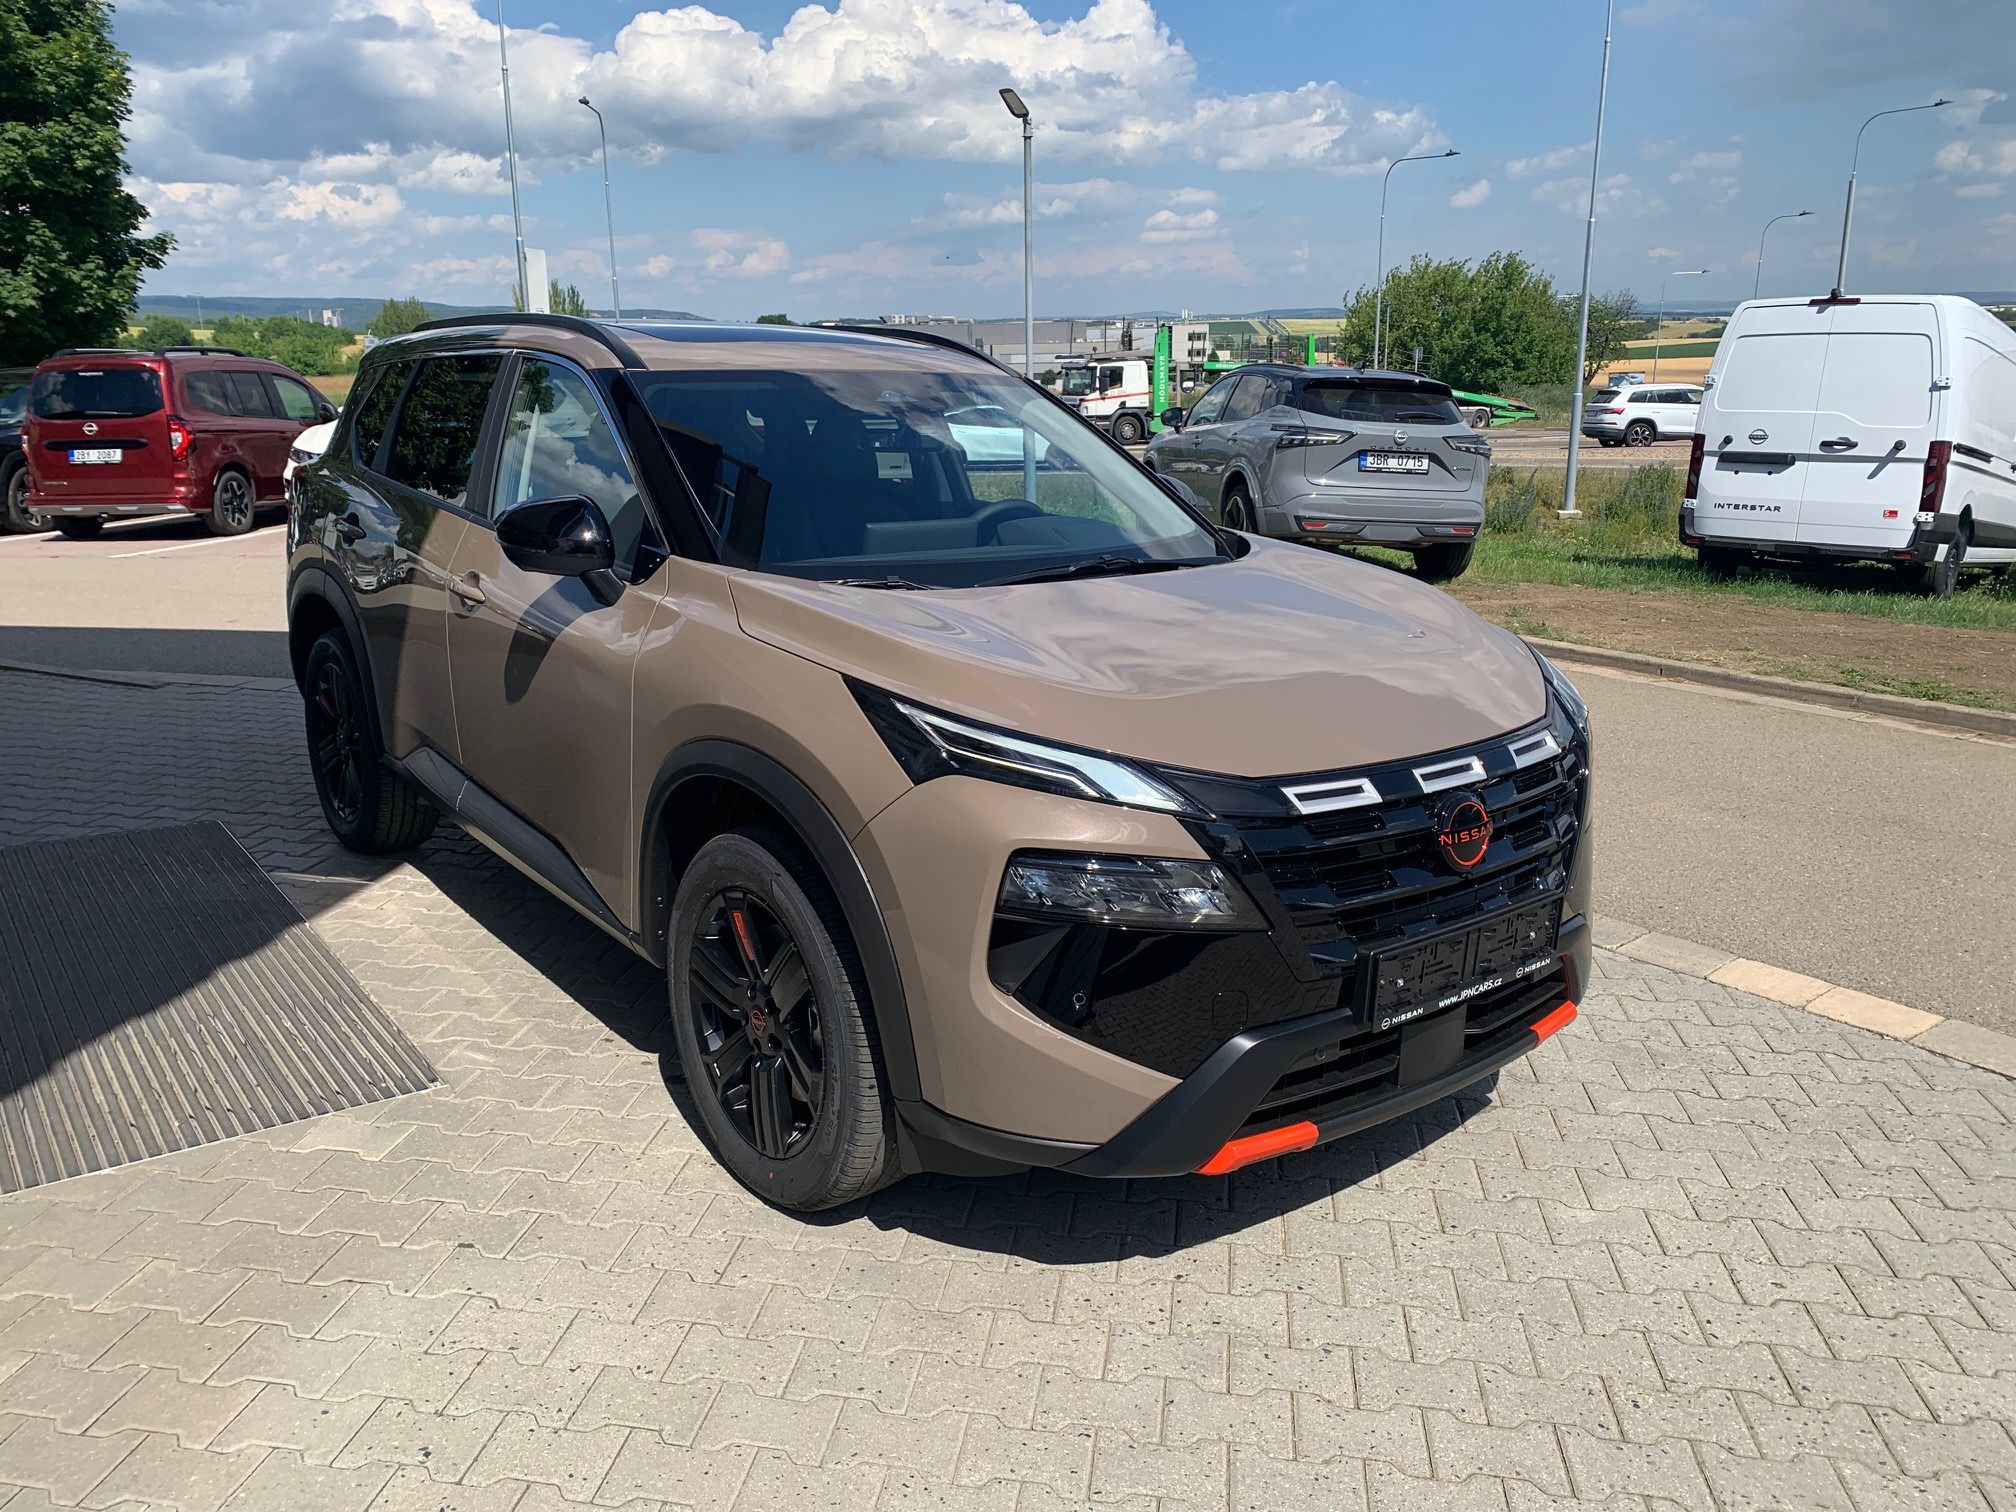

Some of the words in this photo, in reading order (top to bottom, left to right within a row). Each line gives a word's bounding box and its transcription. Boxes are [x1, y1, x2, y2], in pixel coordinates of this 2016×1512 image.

[76, 451, 90, 460] 2BY
[97, 450, 117, 460] 2087
[1369, 453, 1390, 466] 3BR
[1397, 454, 1424, 468] 0715
[1714, 502, 1782, 512] INTERSTAR
[1391, 1007, 1424, 1024] NISSAN
[1438, 977, 1503, 1008] www.JPNCARS.cz
[1524, 957, 1551, 973] NISSAN
